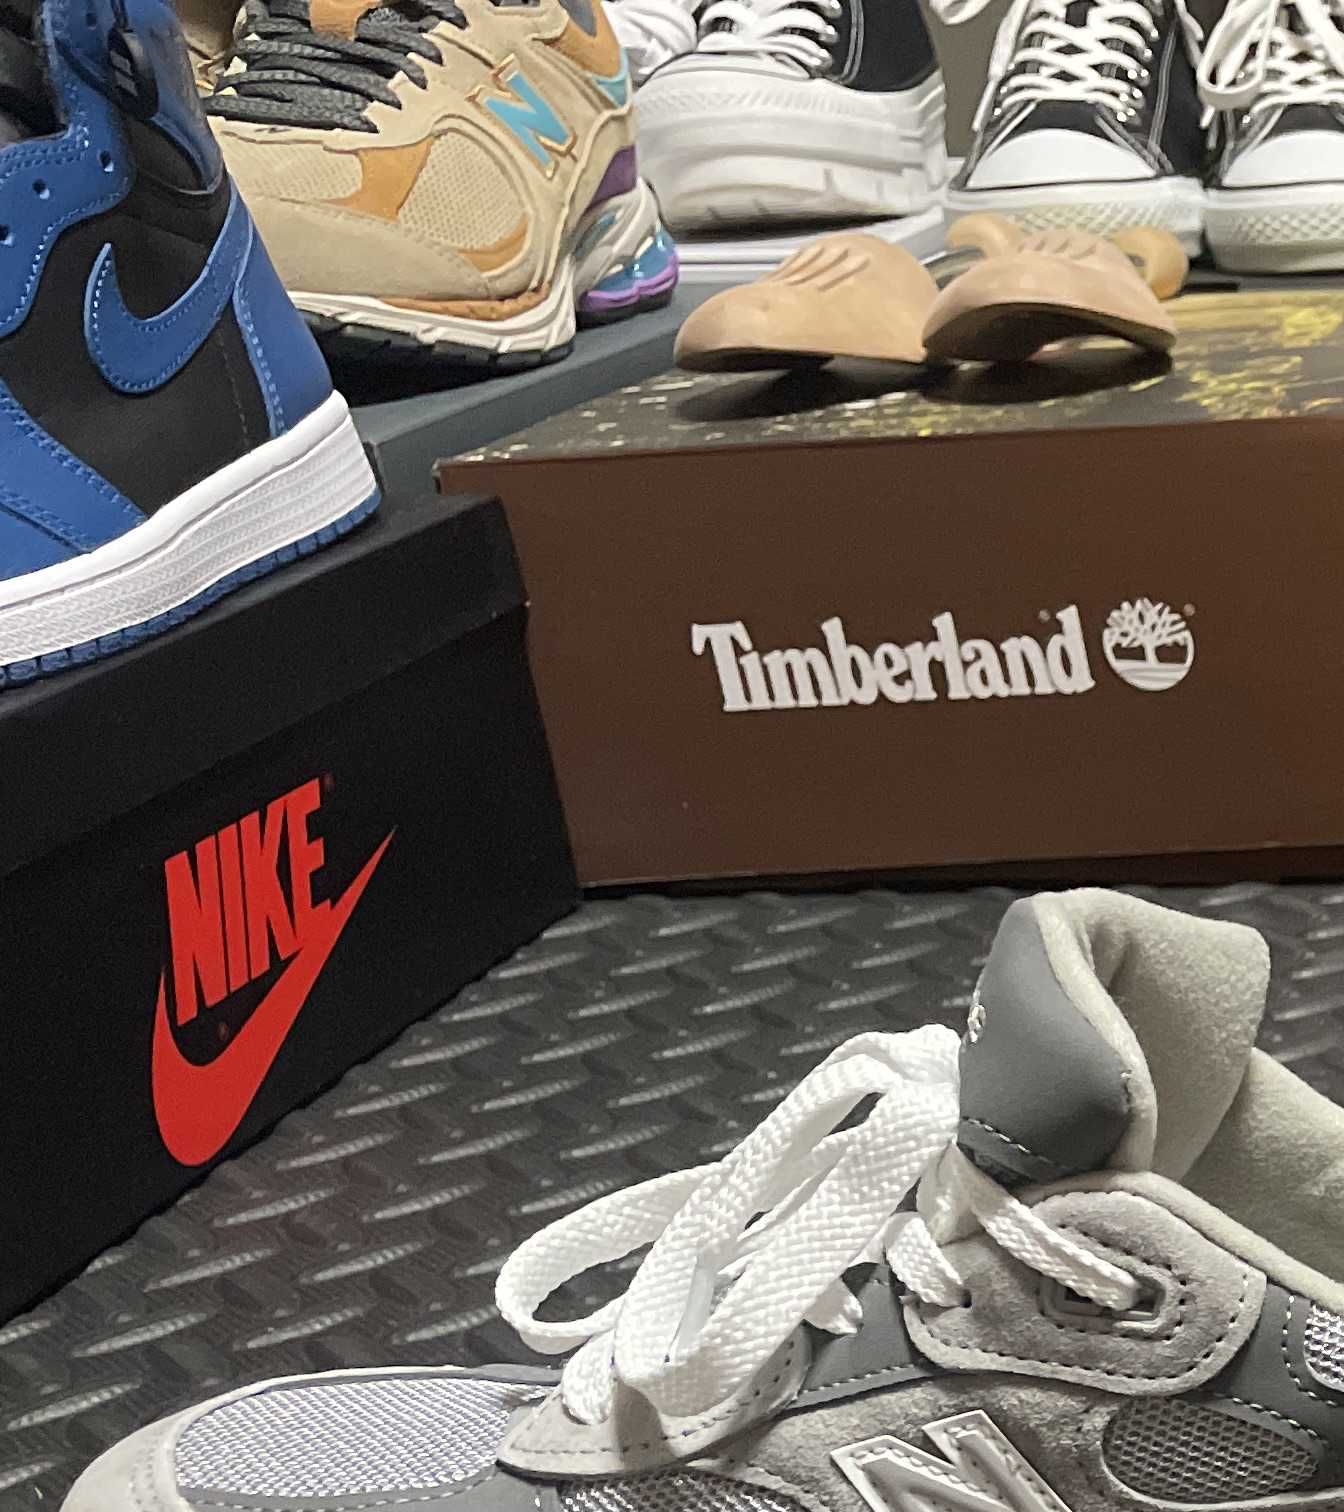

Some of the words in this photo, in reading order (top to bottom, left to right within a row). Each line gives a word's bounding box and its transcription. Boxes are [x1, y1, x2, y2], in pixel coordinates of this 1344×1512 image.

[472, 60, 574, 175] N
[691, 604, 1097, 712] Timberland
[163, 777, 332, 1027] NIKE
